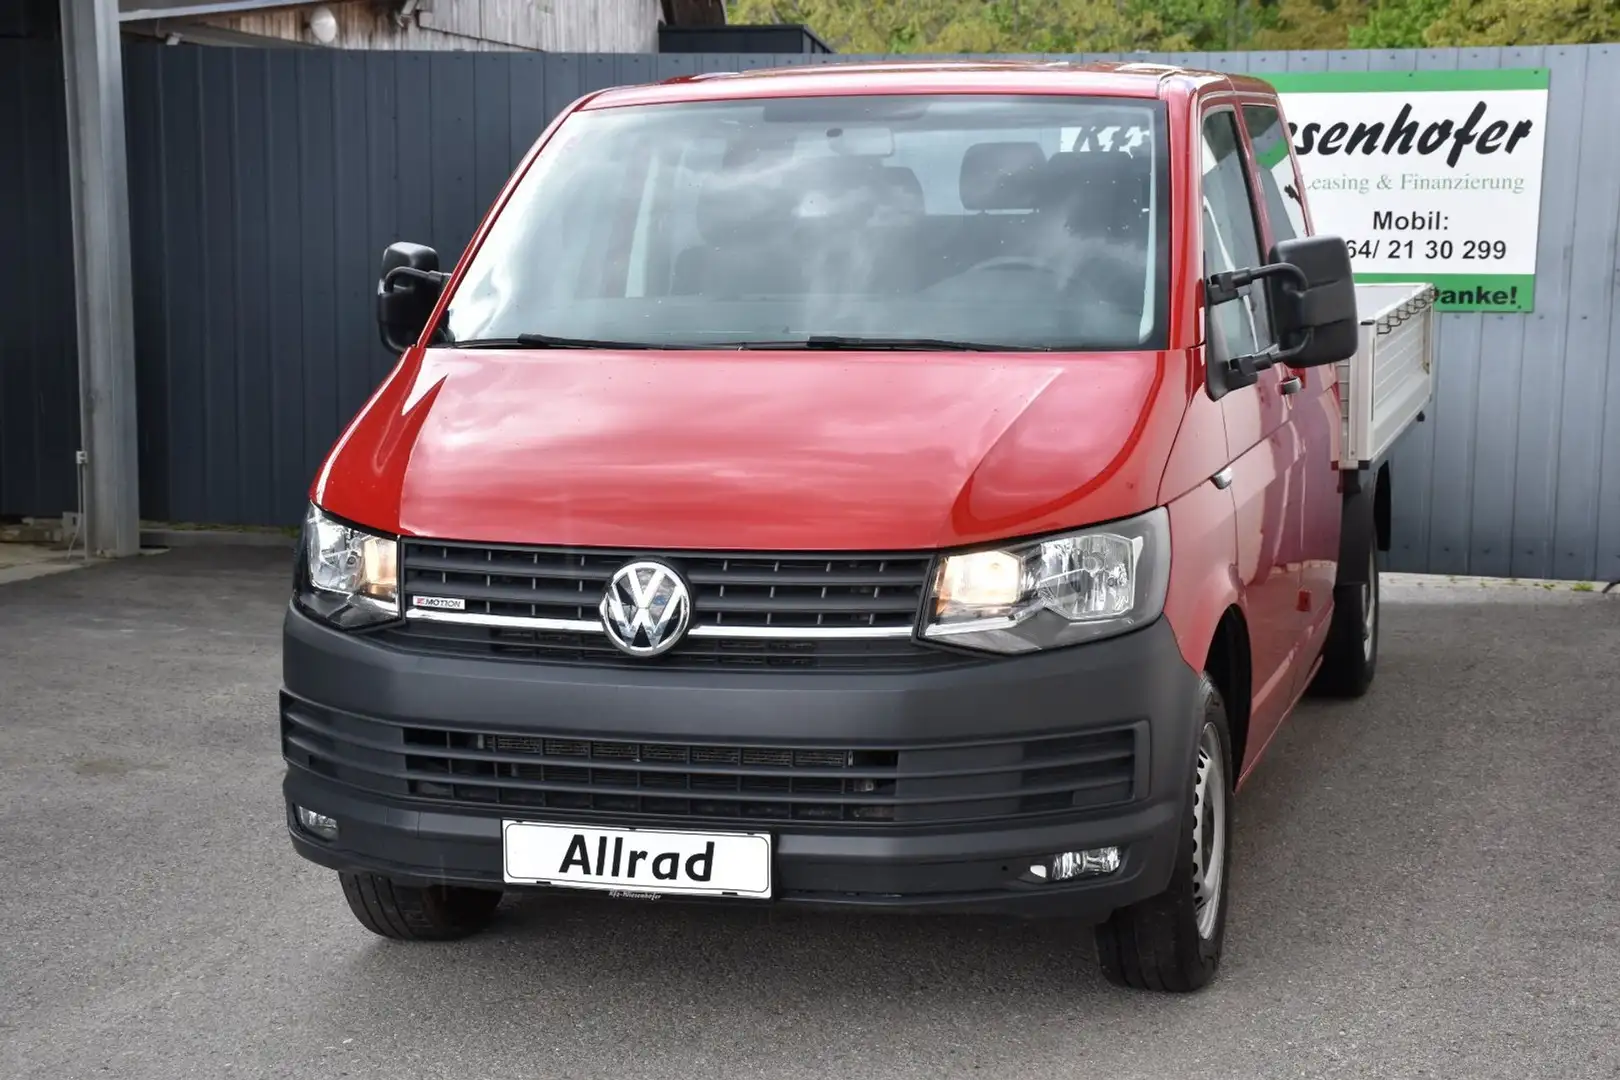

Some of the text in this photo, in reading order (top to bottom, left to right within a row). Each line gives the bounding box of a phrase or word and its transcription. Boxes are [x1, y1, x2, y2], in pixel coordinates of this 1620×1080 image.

[1307, 173, 1525, 194] easing & Finanzierung
[1372, 211, 1449, 231] Mobil:
[1387, 240, 1413, 259] 21
[1425, 240, 1453, 259] 30
[1462, 240, 1506, 260] 299
[558, 834, 715, 882] Allrad
